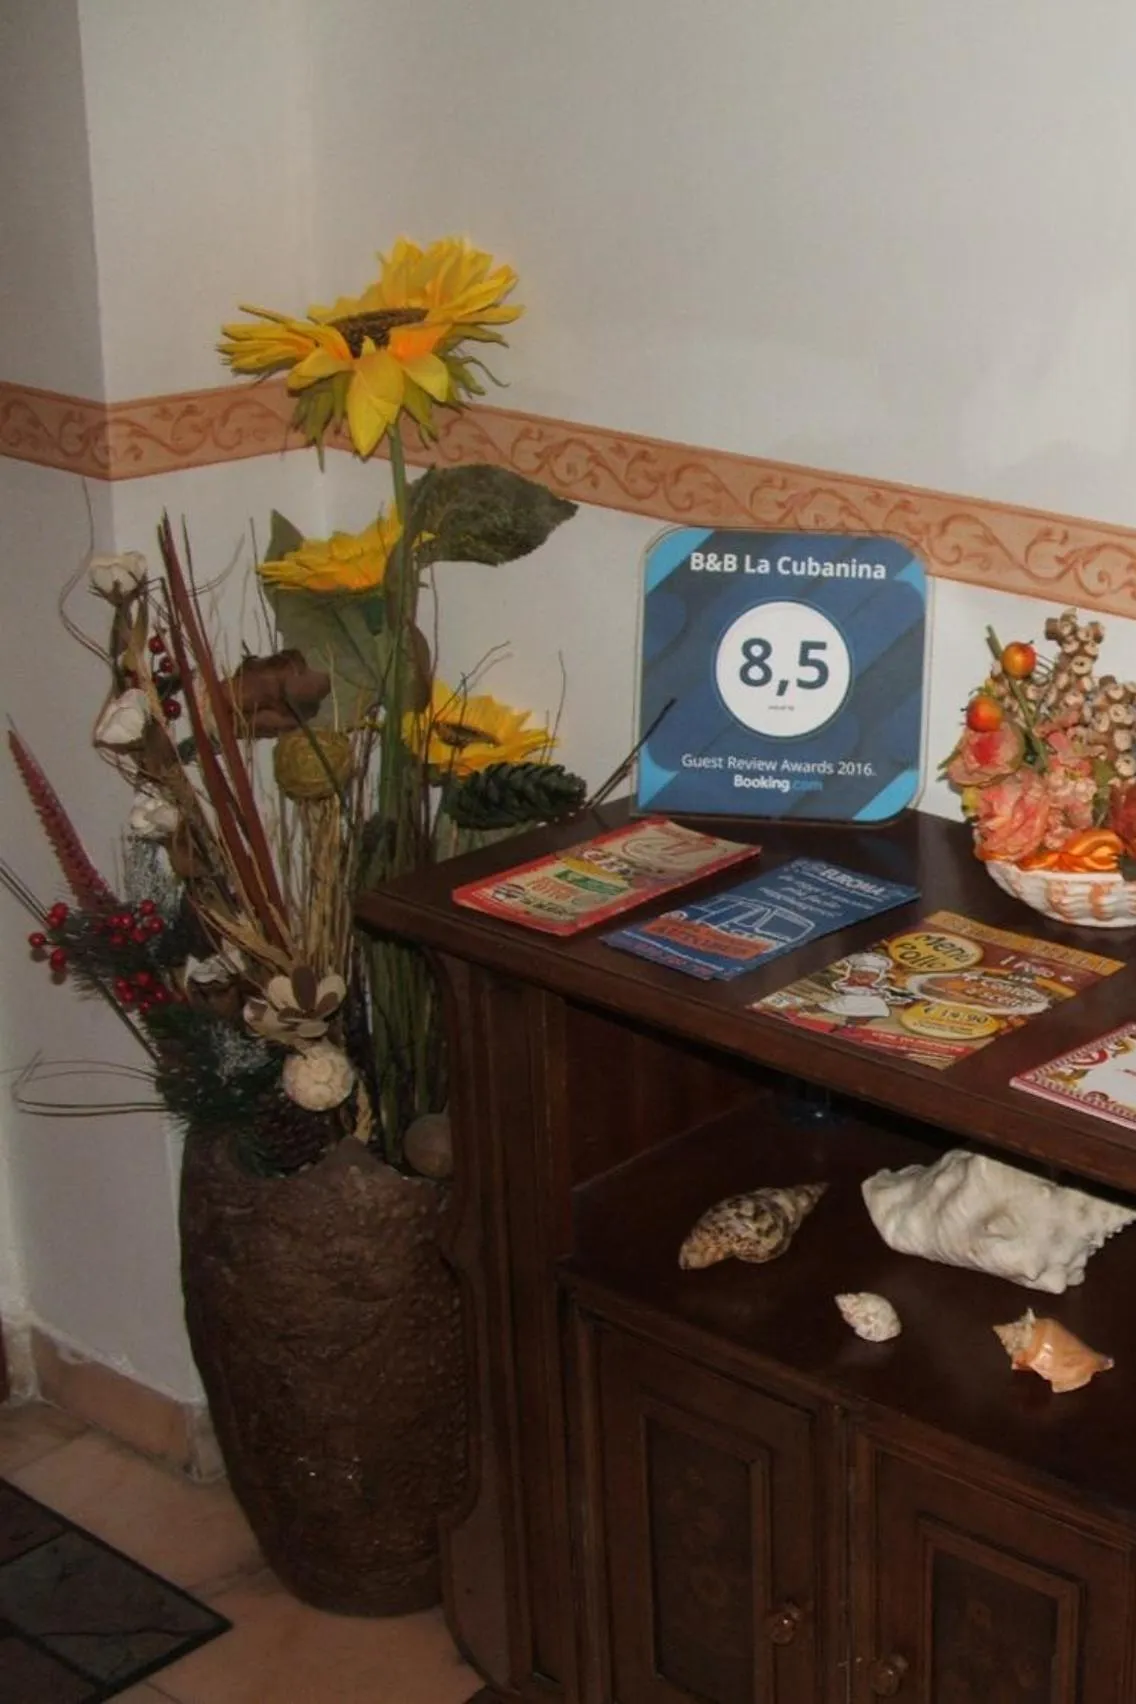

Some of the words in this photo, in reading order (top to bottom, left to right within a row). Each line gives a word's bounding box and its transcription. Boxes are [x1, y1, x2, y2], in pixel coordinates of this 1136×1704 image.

[690, 552, 737, 573] B&B
[744, 555, 771, 574] La
[777, 556, 887, 580] Cubanina
[738, 637, 829, 697] 8,5
[681, 753, 723, 769] Guest
[727, 756, 777, 772] Review
[780, 759, 834, 776] Awards
